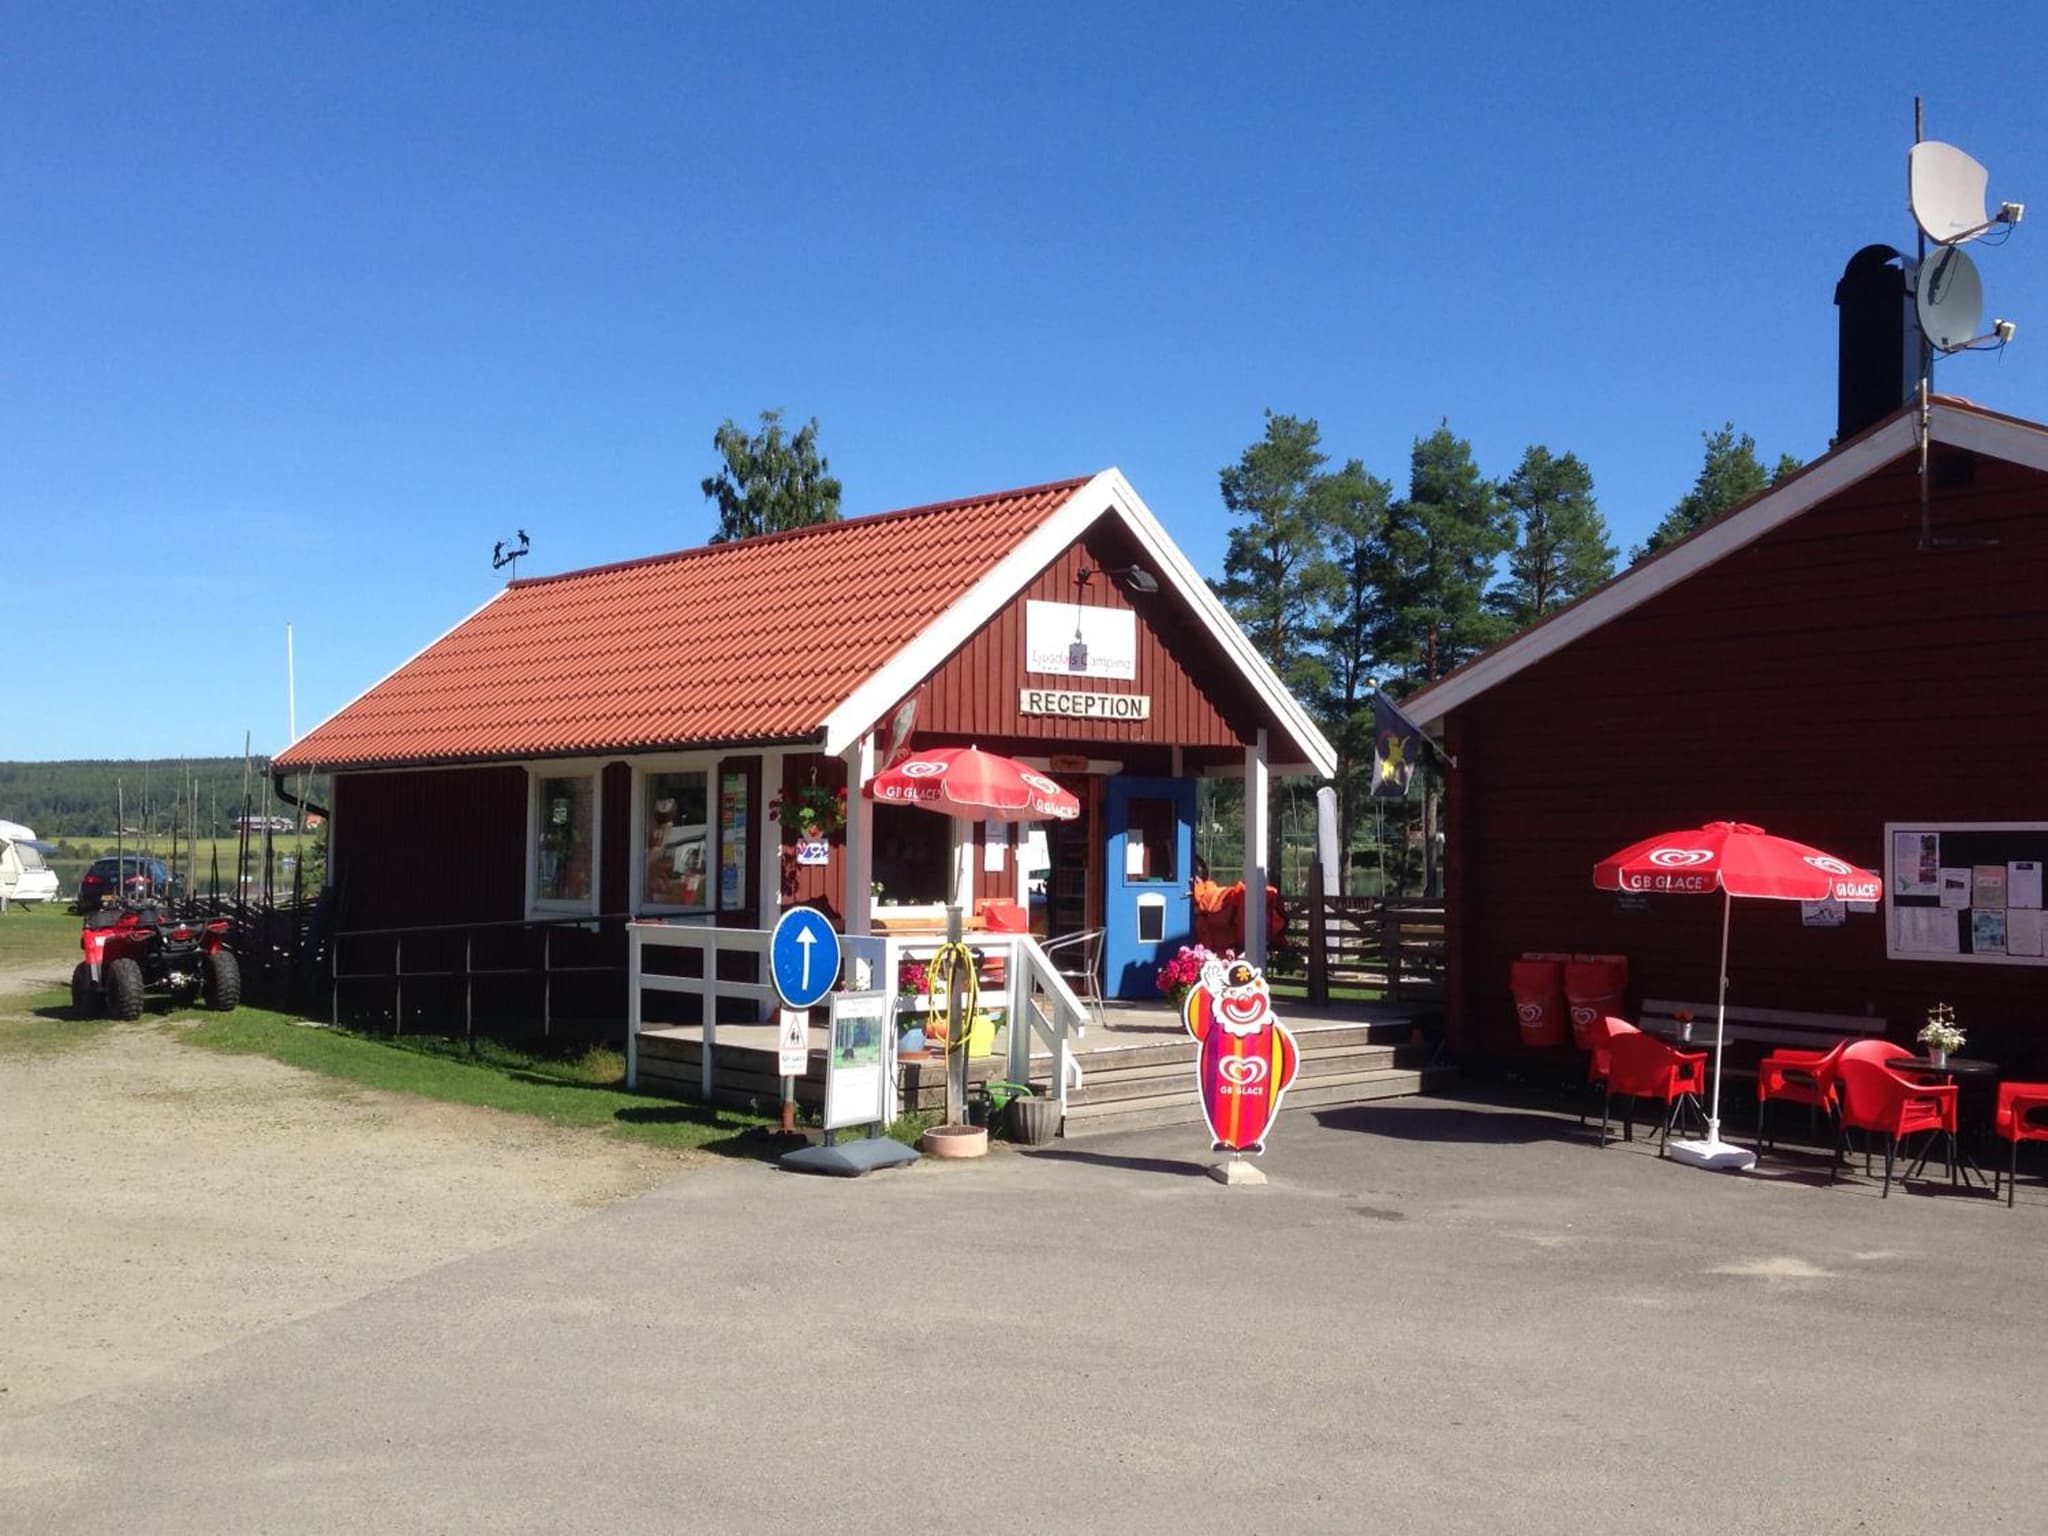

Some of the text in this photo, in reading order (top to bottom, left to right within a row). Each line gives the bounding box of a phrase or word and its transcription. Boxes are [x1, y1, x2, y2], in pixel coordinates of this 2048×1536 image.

[1028, 692, 1142, 716] RECEPTION
[1630, 874, 1703, 890] GB GLACE
[1219, 1085, 1264, 1096] GB GLACE
